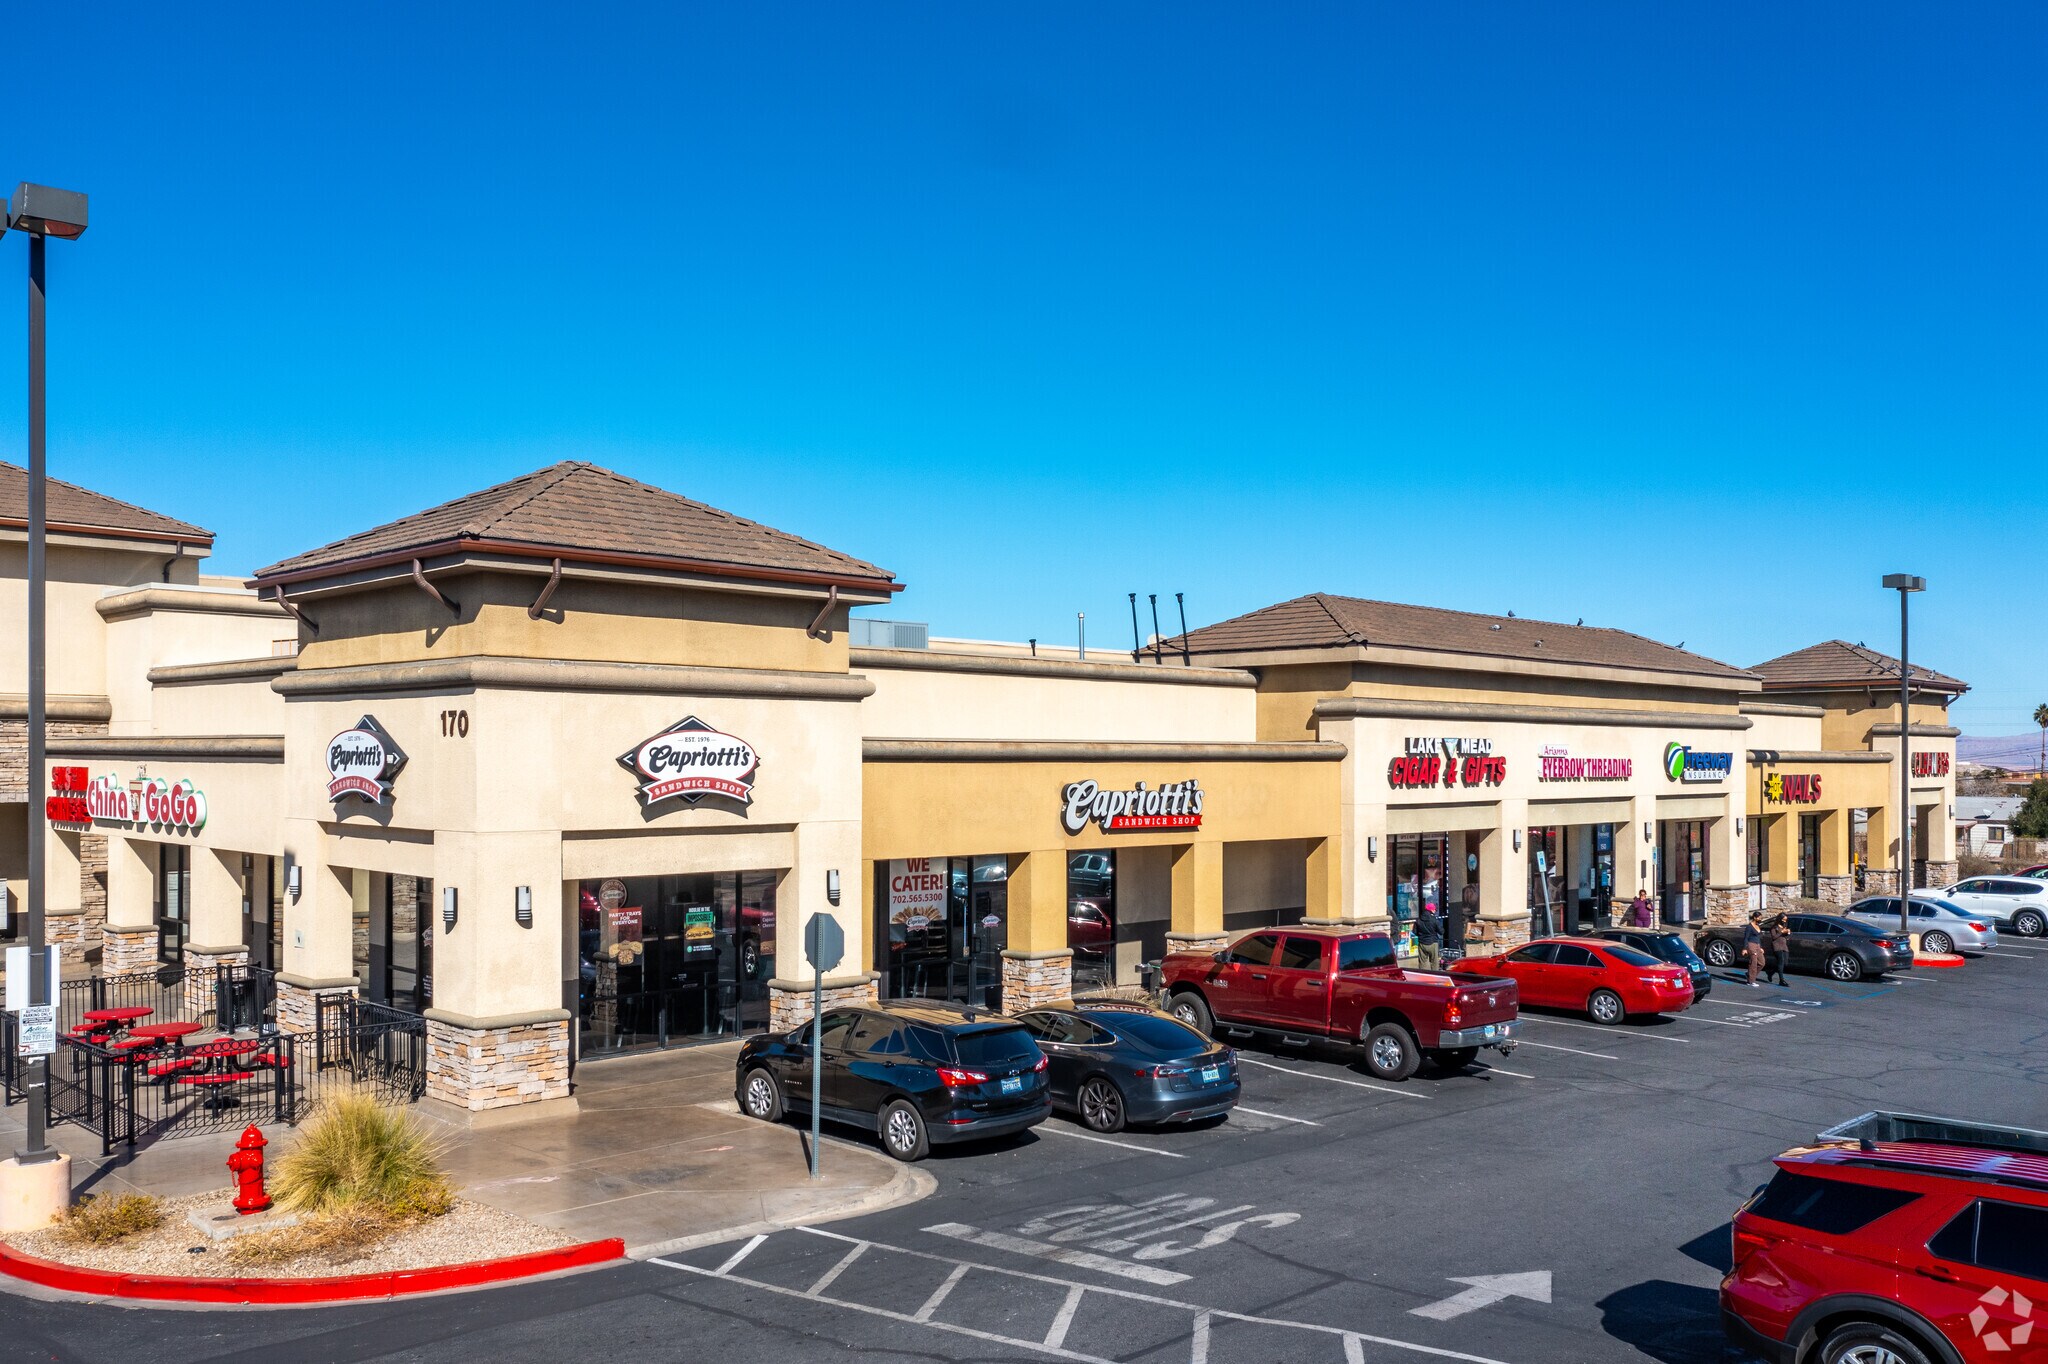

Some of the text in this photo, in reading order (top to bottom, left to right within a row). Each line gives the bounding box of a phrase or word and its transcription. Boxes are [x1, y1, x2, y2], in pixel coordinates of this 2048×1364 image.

[440, 709, 469, 738] 170
[1409, 737, 1493, 754] LAKE MEAD
[1543, 745, 1568, 756] Arianna
[331, 744, 381, 772] Capriotti's
[649, 744, 750, 773] Capriotti's
[1685, 746, 1733, 775] Freeway
[1392, 756, 1506, 784] CIGAR & GIFTS
[1542, 758, 1632, 778] EYEBROW THREADING
[1685, 771, 1726, 779] INSURANCE
[332, 778, 360, 793] SANDWICH
[654, 779, 742, 795] SANDWICH SHOP
[1770, 774, 1822, 800] HOT NAILS
[87, 777, 128, 818] China
[145, 781, 198, 825] GoGo
[1065, 779, 1205, 830] Capriotti's
[1118, 817, 1195, 826] SANDWICH SHOP
[906, 858, 930, 873] WE
[892, 874, 944, 893] CATER!
[892, 892, 943, 905] 702.565.5300
